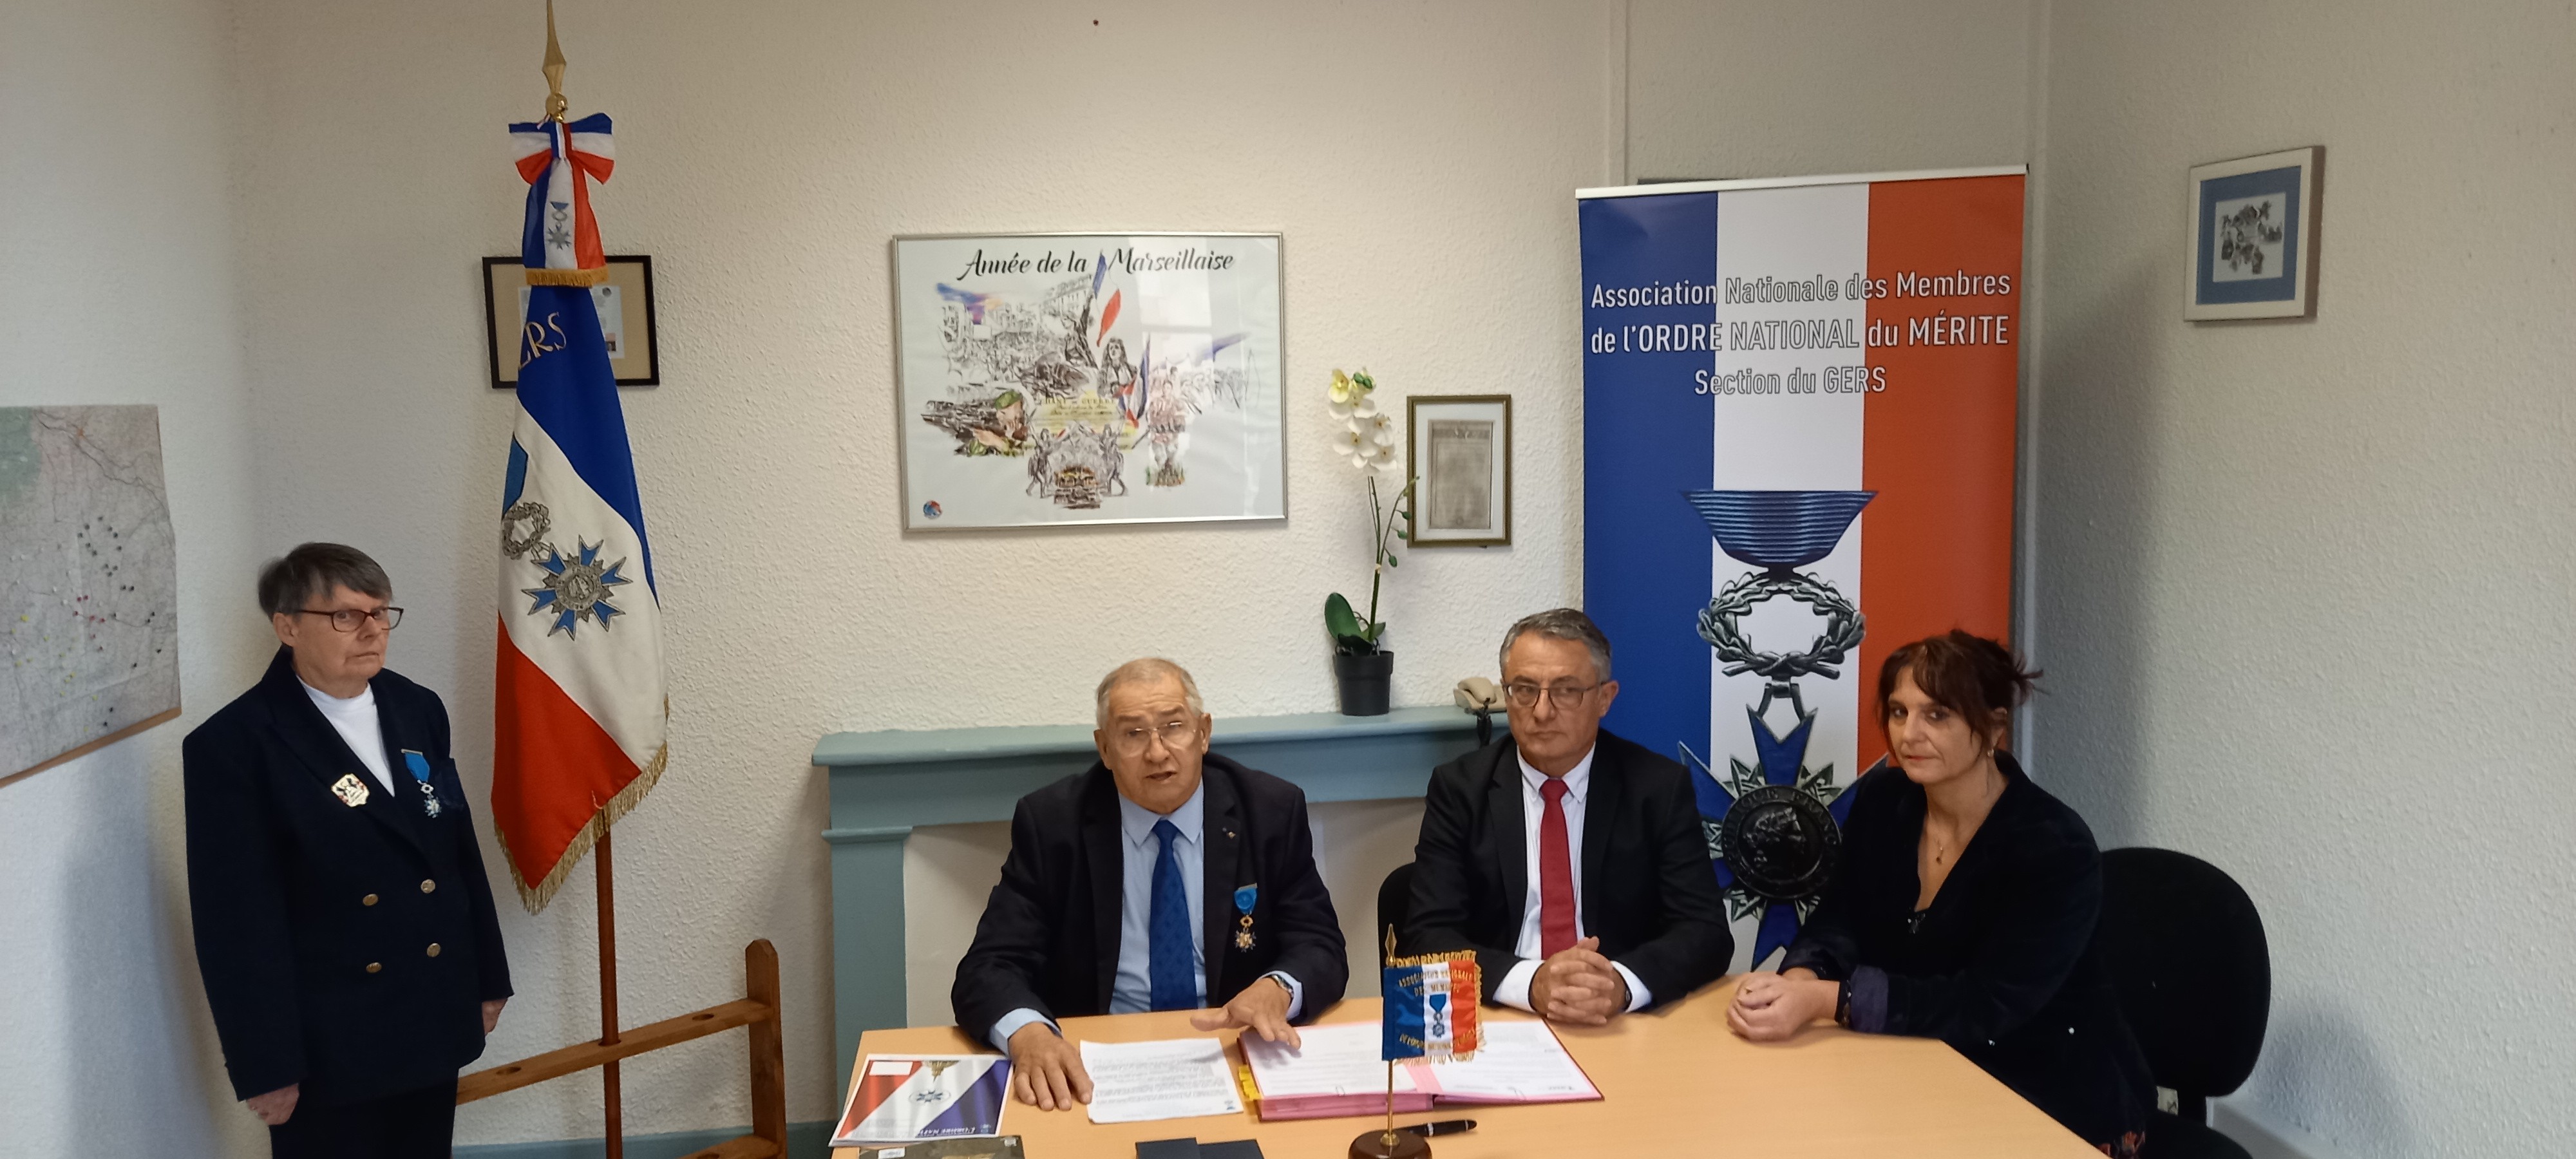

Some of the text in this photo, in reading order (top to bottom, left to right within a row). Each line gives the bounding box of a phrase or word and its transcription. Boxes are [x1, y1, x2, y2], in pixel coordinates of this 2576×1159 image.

[956, 247, 1233, 281] Année de la Marseillaise
[1591, 269, 2012, 308] Association Nationale des Membres
[1591, 309, 2010, 354] de l'ORDRE NATIONAL du MÉRITE
[1694, 366, 1887, 395] Section du GERS
